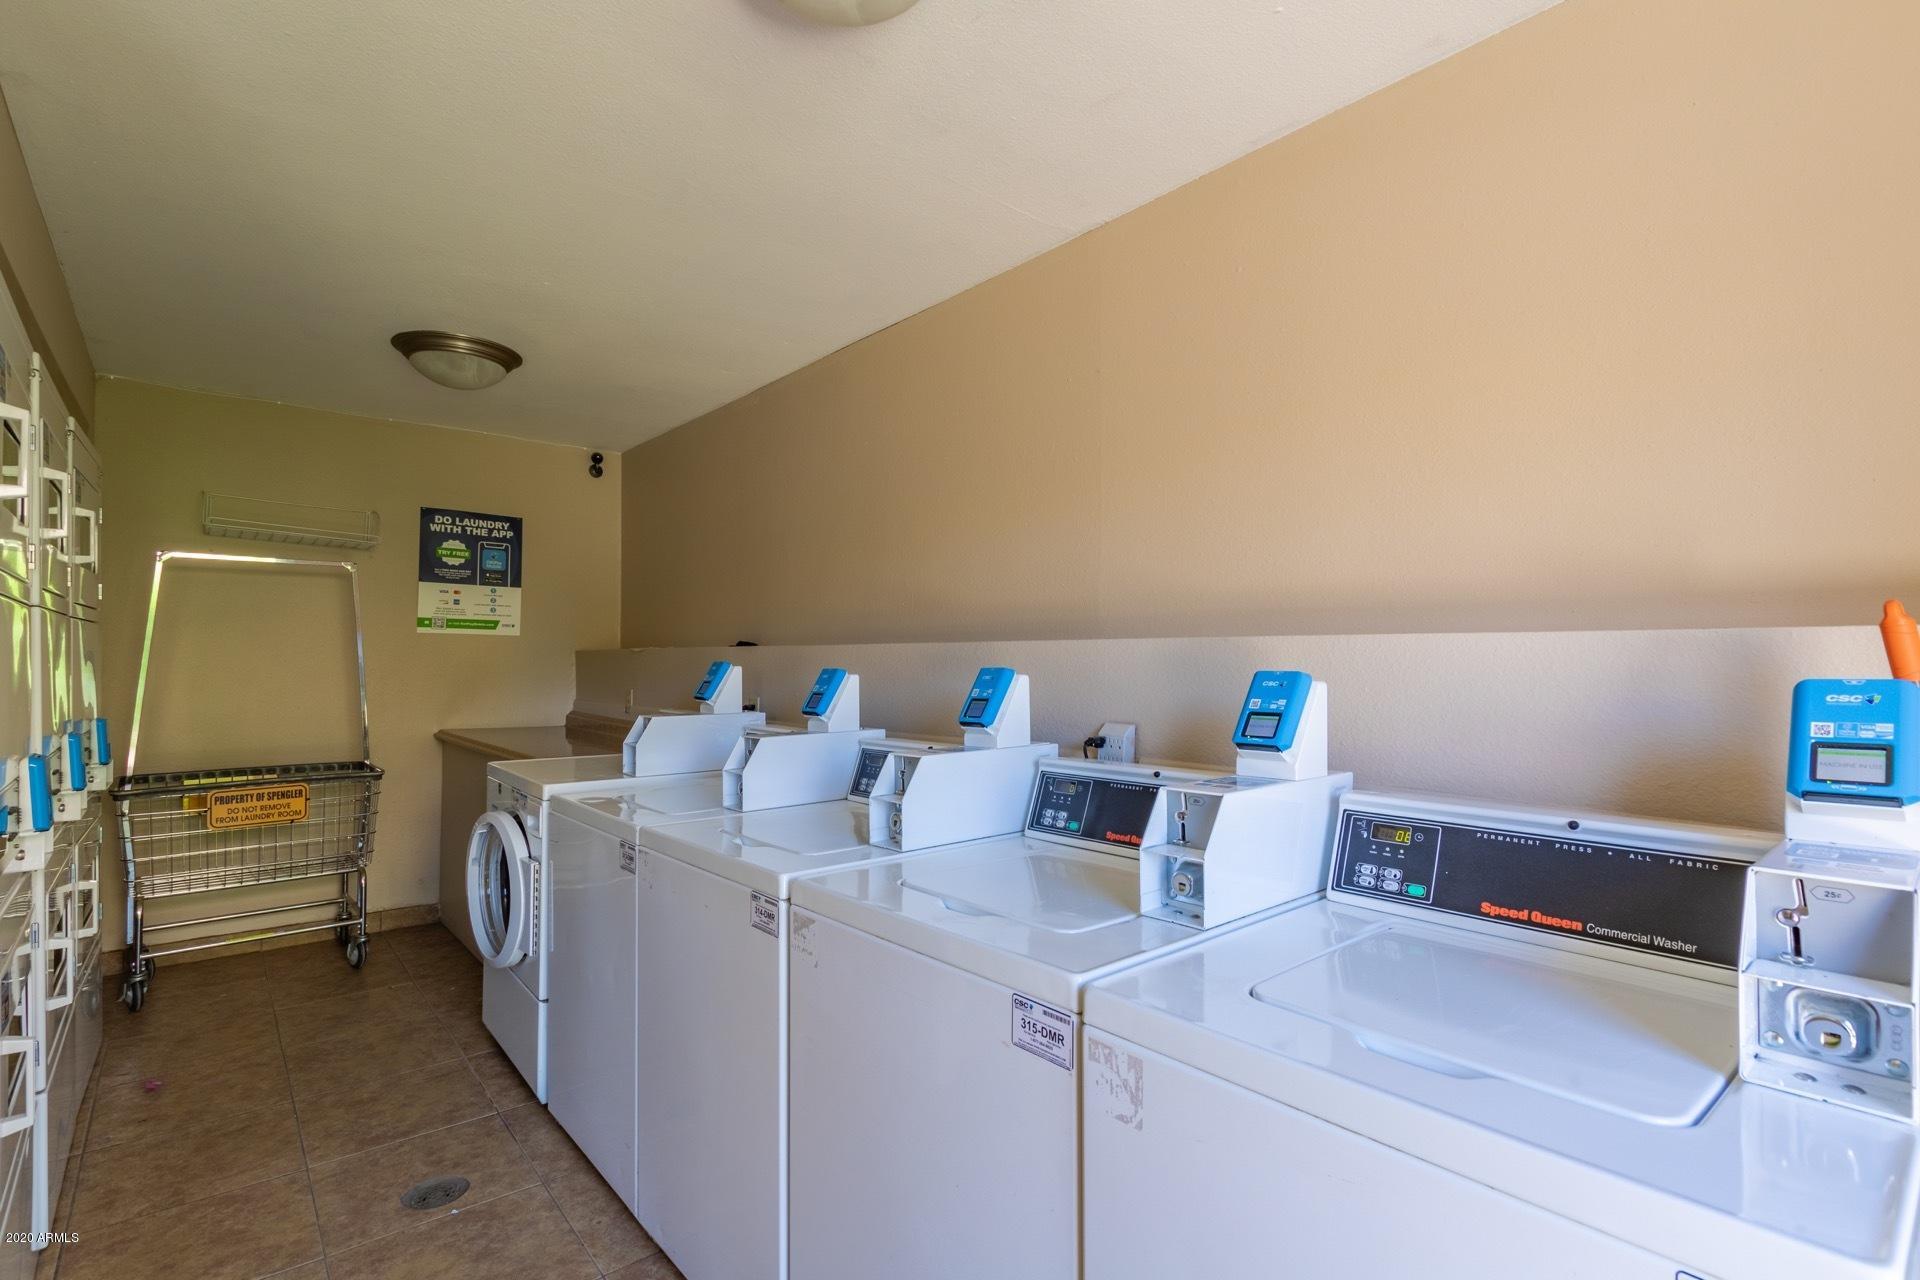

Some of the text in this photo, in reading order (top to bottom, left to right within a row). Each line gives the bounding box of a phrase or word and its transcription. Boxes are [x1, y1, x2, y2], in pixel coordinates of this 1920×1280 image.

[434, 515, 510, 530] DO LAUNDRY
[430, 523, 514, 539] WITH THE APP
[1825, 694, 1863, 702] CSC
[214, 789, 303, 806] PROPERTY OF SPENGLER
[242, 806, 258, 814] NOT
[260, 802, 291, 812] REMOVE
[216, 809, 302, 825] FROM LAUNDRY ROOM
[1476, 832, 1719, 871] PERMANENT PRESS ALL FABRIC
[1480, 901, 1697, 953] Speed Queen Commercial Washer
[1014, 998, 1029, 1009] CSC
[1021, 1017, 1065, 1047] 315-DMR
